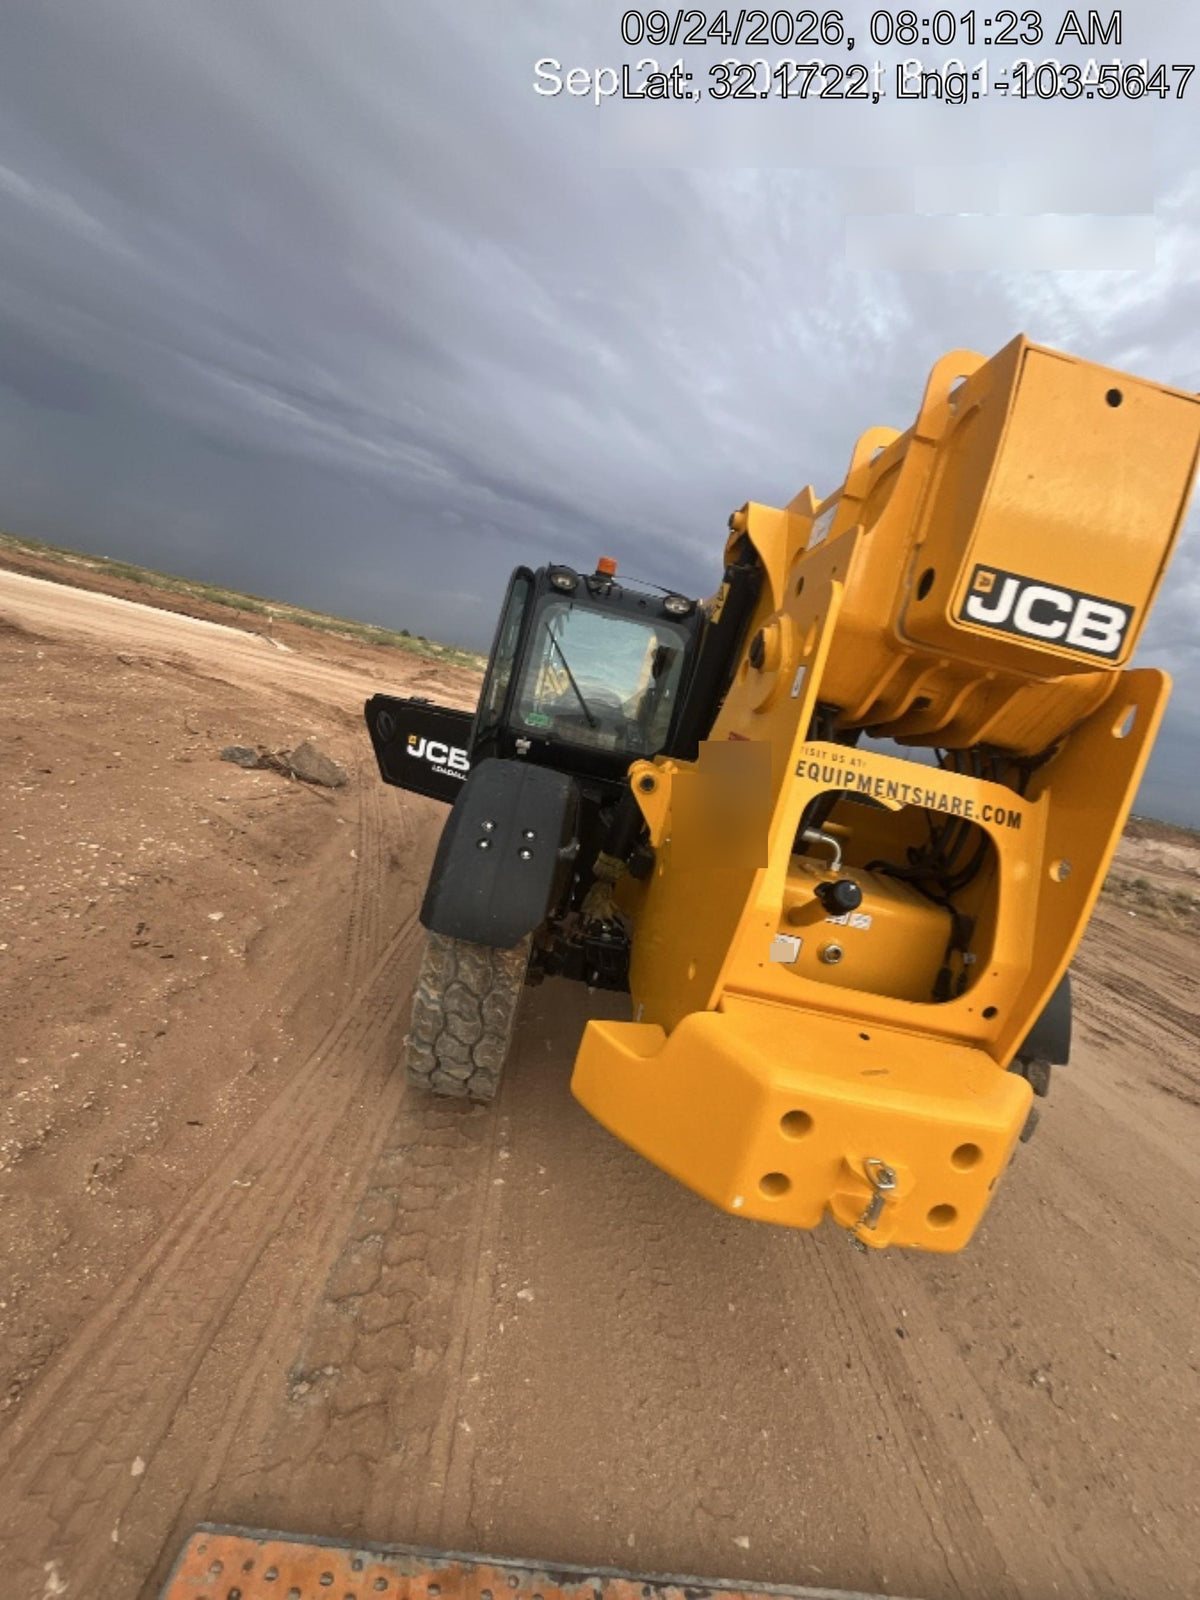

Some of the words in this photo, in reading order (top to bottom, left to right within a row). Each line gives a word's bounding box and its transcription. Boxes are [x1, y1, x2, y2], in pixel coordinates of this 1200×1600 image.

[966, 577, 1127, 654] JCB
[407, 737, 470, 771] JCB
[831, 753, 845, 763] US
[796, 760, 1022, 830] EQUIPMENTSHARE.COM
